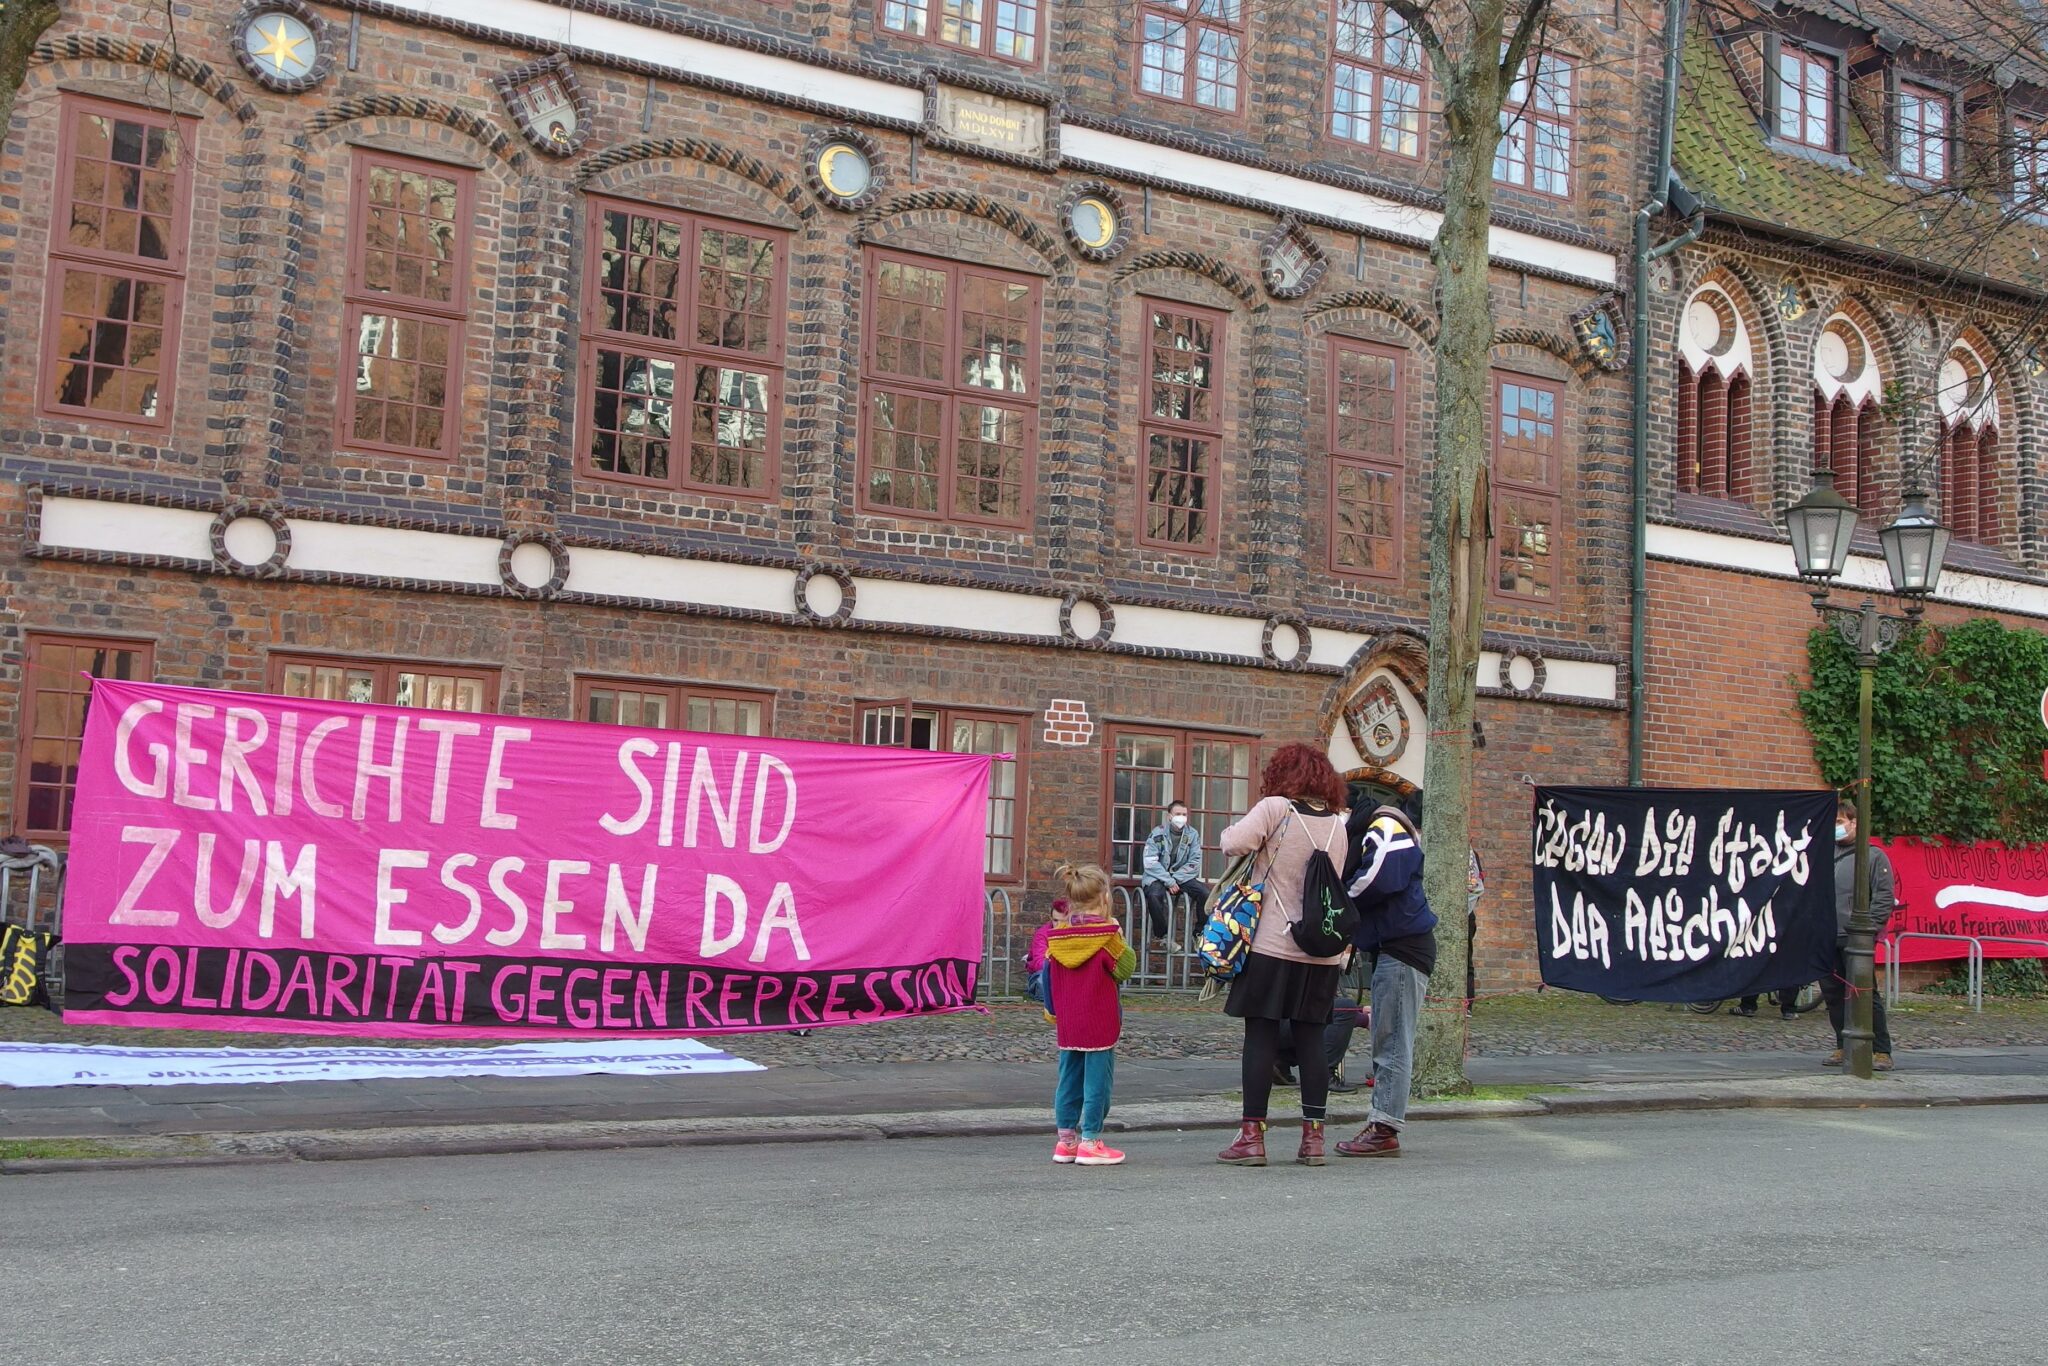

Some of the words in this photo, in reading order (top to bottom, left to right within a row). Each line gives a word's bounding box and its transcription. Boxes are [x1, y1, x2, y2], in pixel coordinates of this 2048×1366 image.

[960, 108, 987, 122] ANNO
[114, 699, 531, 829] GERICHTE
[599, 737, 797, 853] SIND
[1925, 846, 2000, 882] UNFUG
[108, 826, 317, 939] ZUM
[374, 848, 658, 952] ESSEN
[699, 873, 811, 961] DA
[1915, 916, 1956, 935] Linke
[1961, 913, 2034, 937] Freiräume
[491, 964, 669, 1028] GEGEN
[685, 962, 977, 1027] REPRESSION
